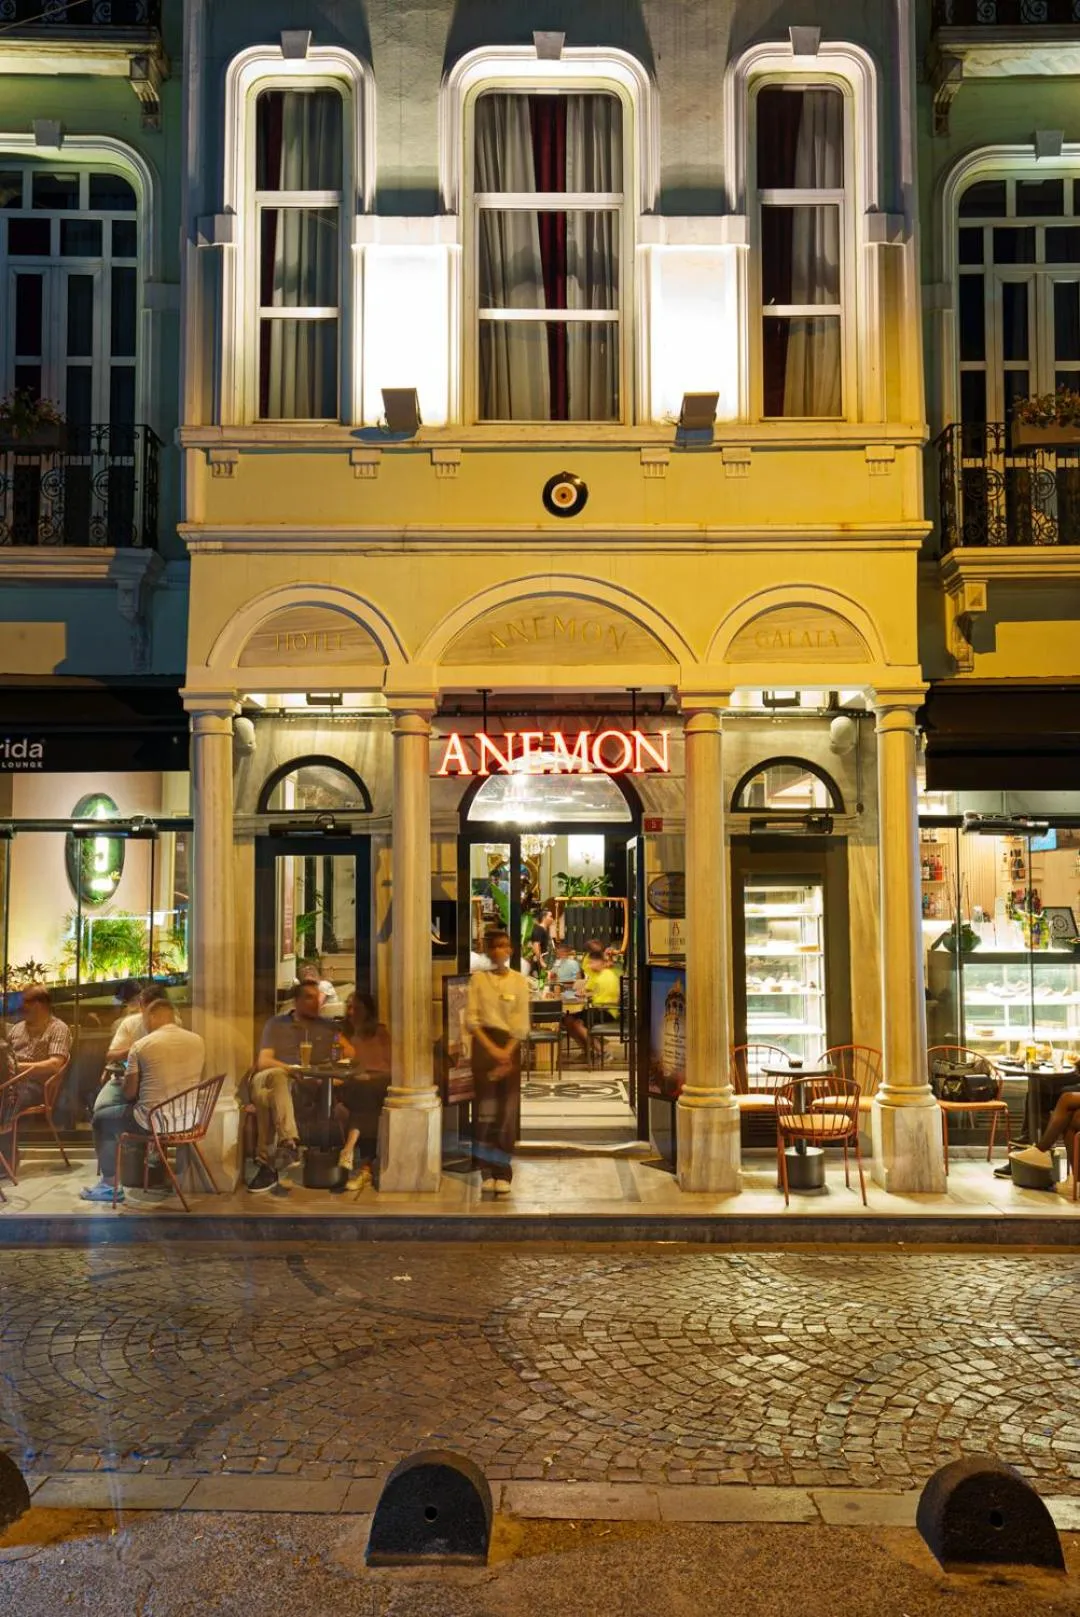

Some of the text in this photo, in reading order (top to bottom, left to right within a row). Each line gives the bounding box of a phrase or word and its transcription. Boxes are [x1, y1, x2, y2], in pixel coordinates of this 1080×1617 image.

[275, 631, 346, 652] HOTEL
[489, 615, 627, 652] ANEMON
[754, 630, 840, 649] GALATA
[437, 730, 671, 776] ANEMON
